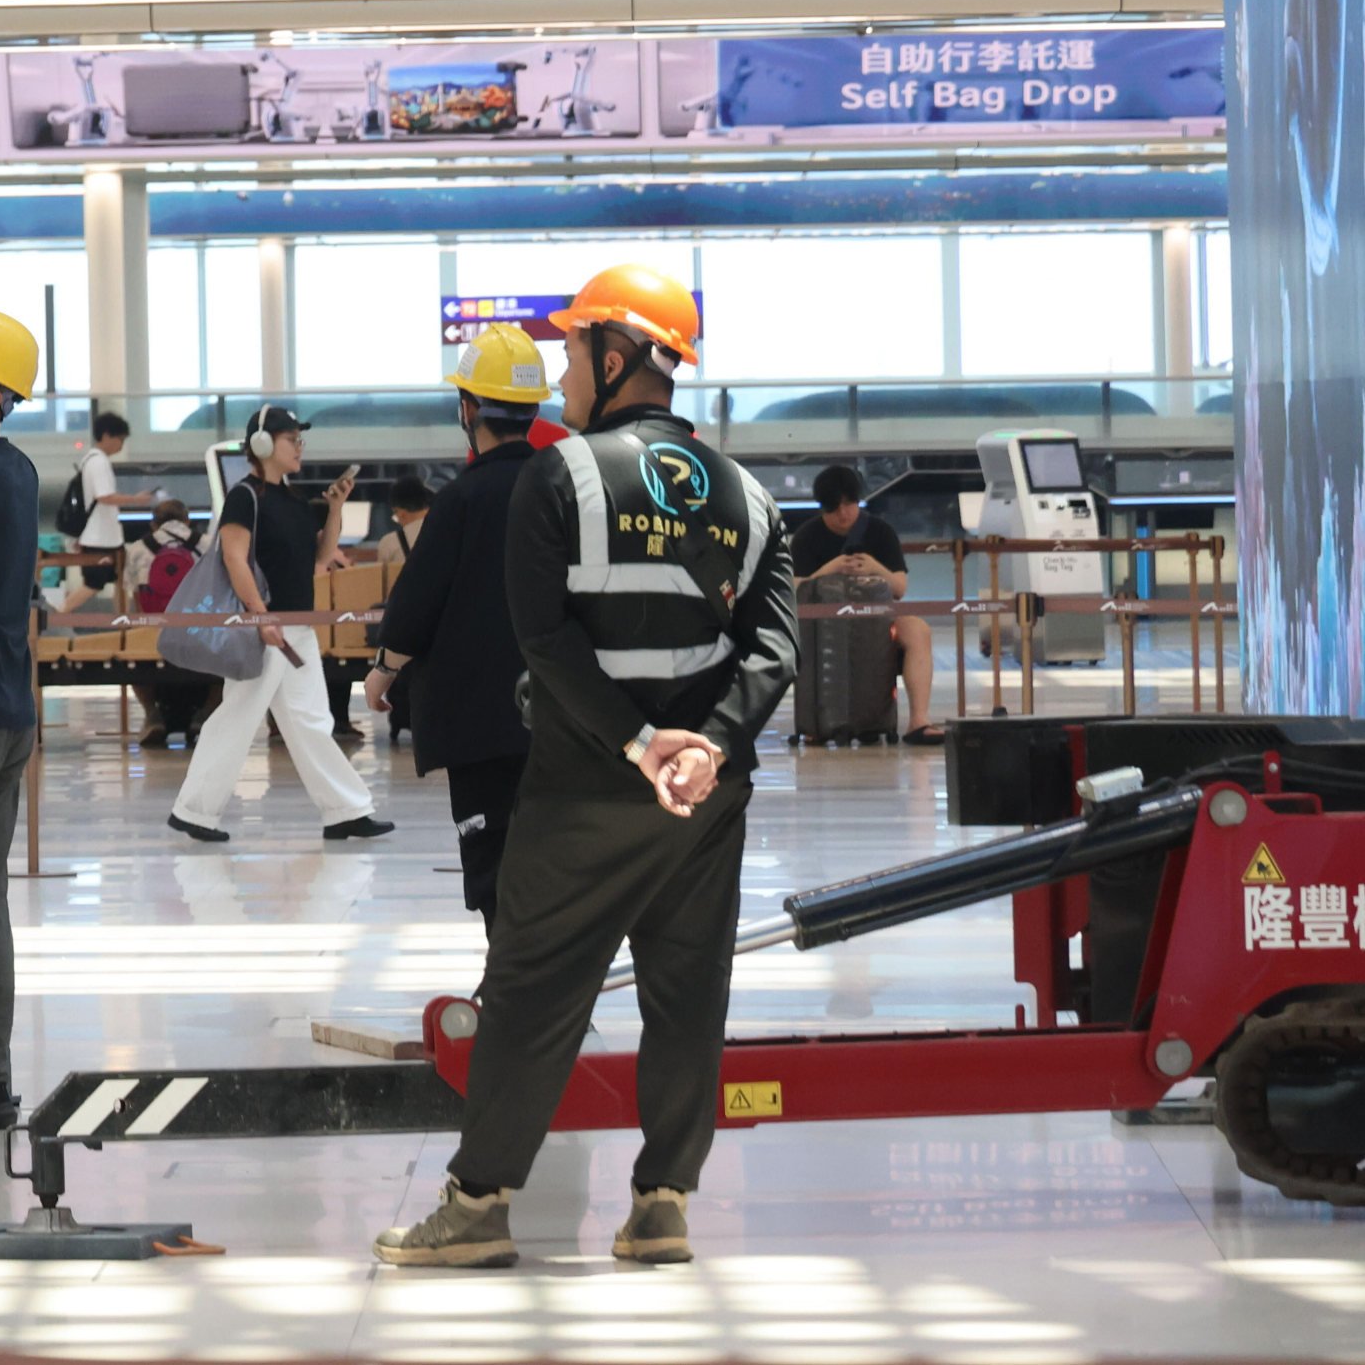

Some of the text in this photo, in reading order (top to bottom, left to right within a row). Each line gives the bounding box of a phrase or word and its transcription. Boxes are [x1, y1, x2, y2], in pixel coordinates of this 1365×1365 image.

[861, 39, 1095, 75] 自助行李託運
[841, 79, 1117, 114] Self Bag Drop
[1244, 883, 1365, 952] 隆豐
